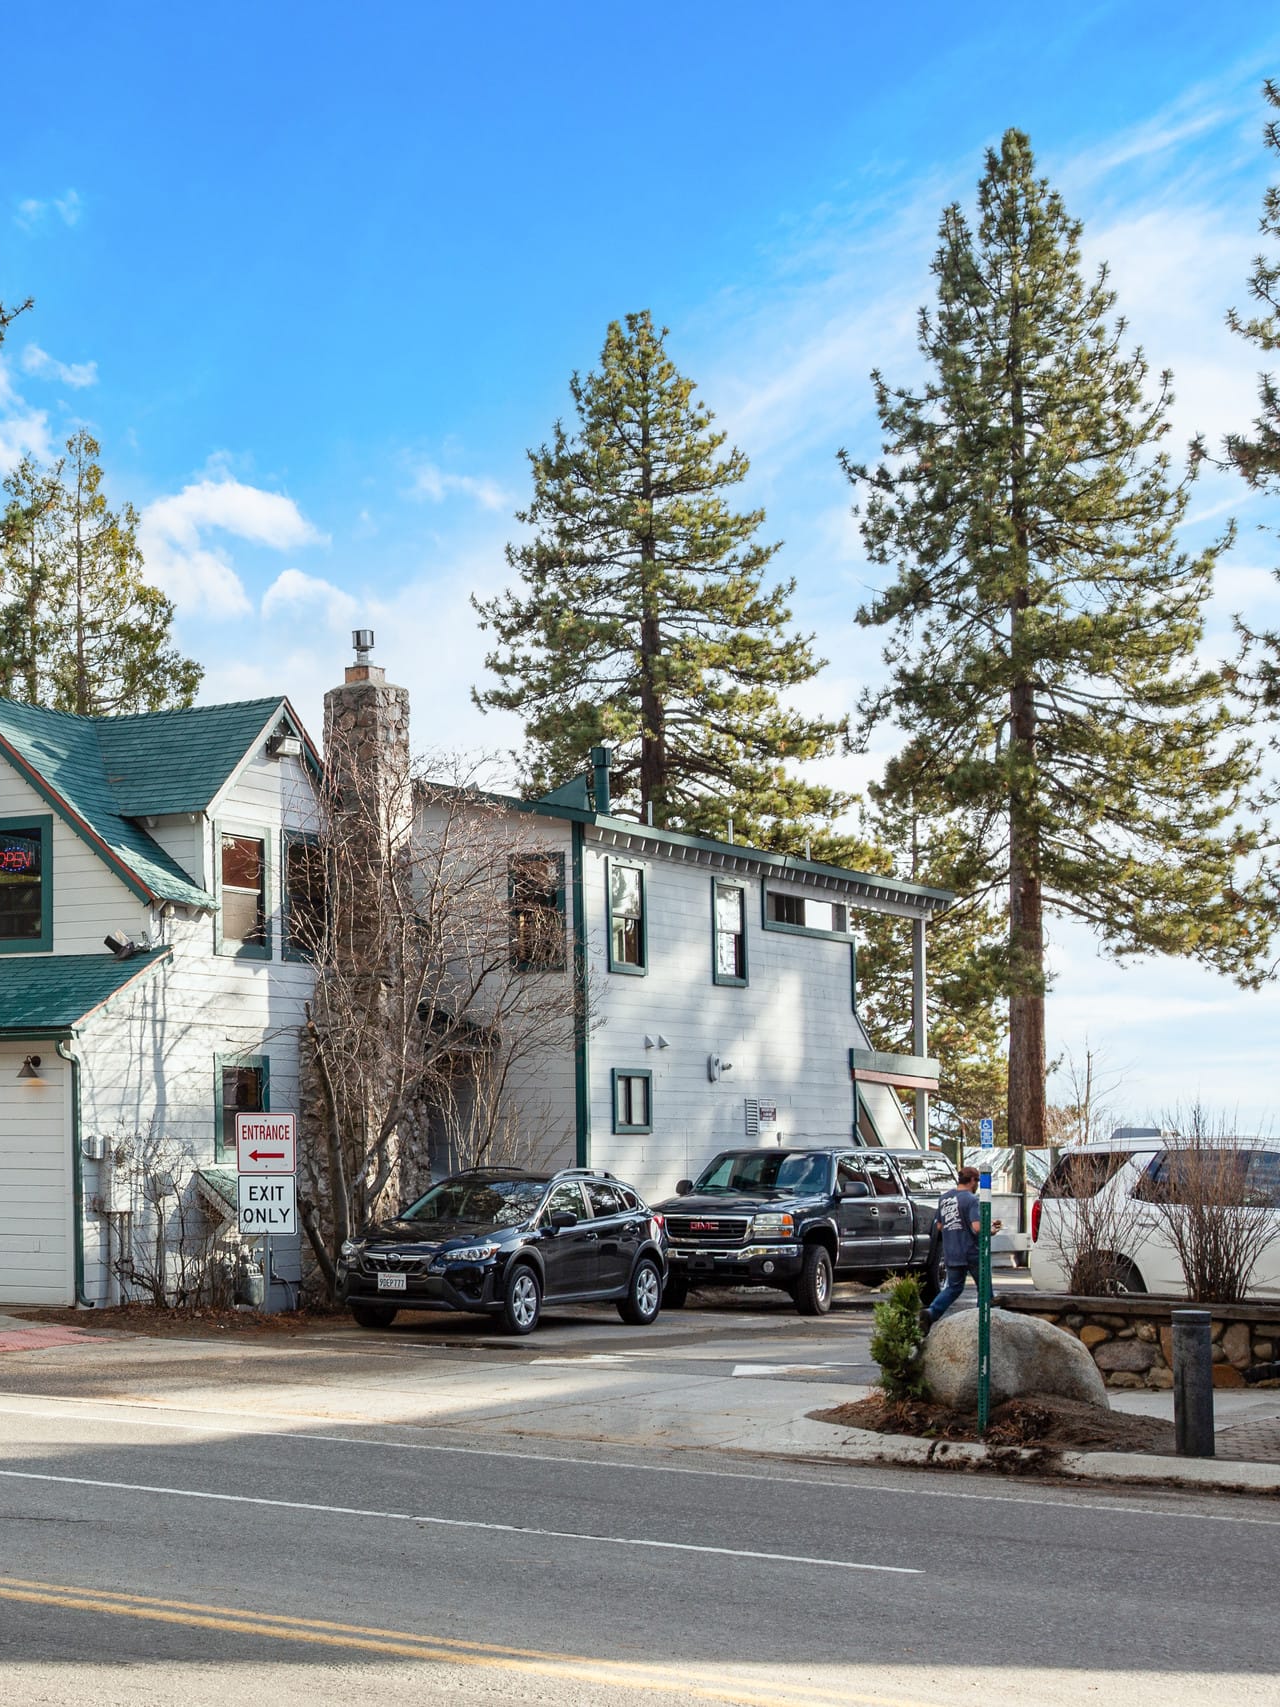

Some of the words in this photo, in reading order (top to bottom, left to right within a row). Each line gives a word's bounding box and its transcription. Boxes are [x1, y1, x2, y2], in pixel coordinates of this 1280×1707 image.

[241, 1124, 290, 1140] ENTRANCE
[249, 1185, 285, 1201] EXIT
[243, 1208, 290, 1224] ONLY
[689, 1221, 720, 1230] GMC
